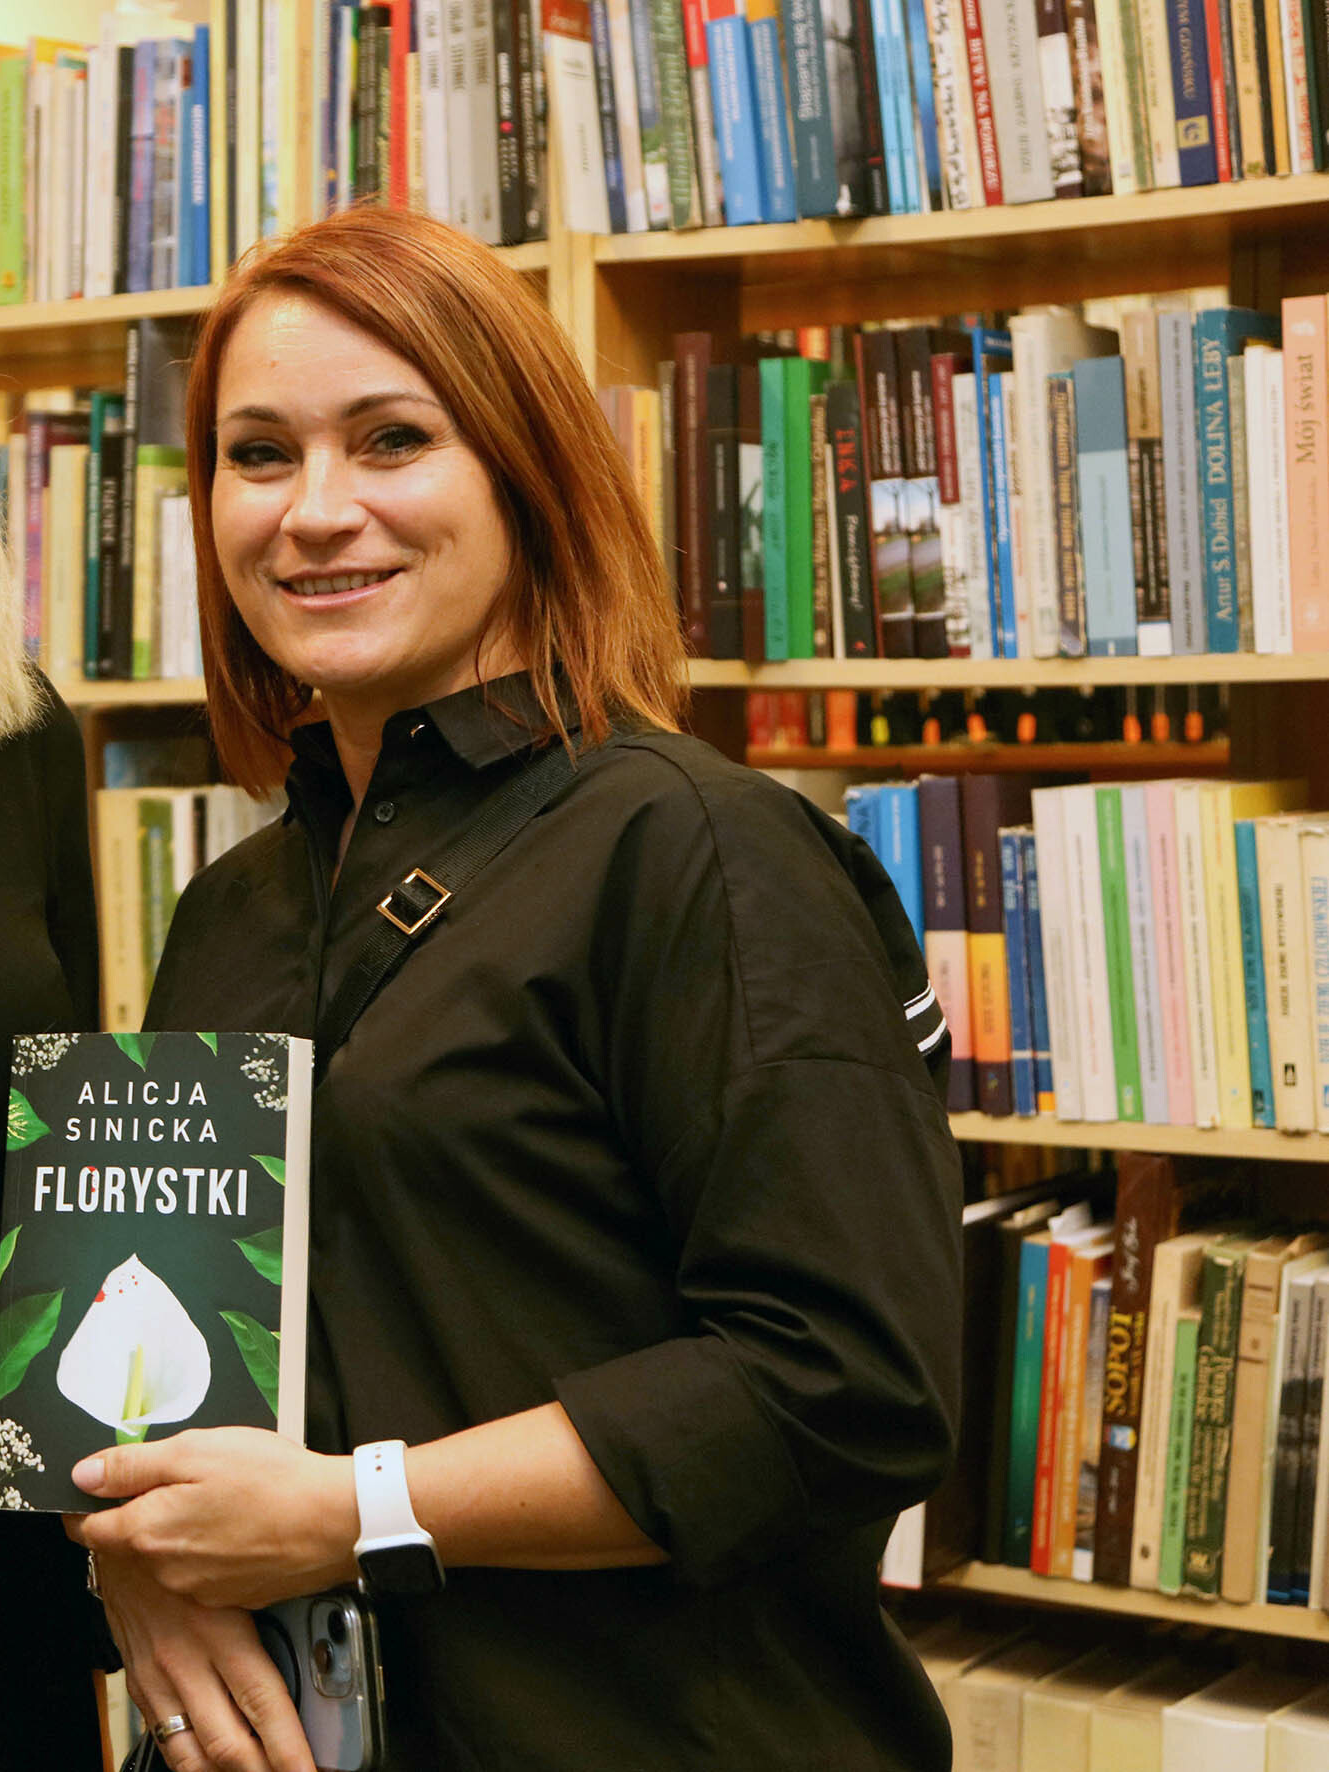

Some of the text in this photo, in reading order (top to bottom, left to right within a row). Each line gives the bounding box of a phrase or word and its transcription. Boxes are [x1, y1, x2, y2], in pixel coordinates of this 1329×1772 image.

[1294, 354, 1314, 411] świat
[1206, 400, 1227, 484] DOLINA
[1295, 418, 1321, 464] Mój
[1209, 498, 1230, 553] Dubiel
[1215, 577, 1233, 624] Artur
[78, 1081, 208, 1106] ALICJA
[65, 1117, 218, 1143] SINICKA
[34, 1165, 248, 1216] FLORYSTKI
[1105, 1310, 1133, 1416] SOPOT
